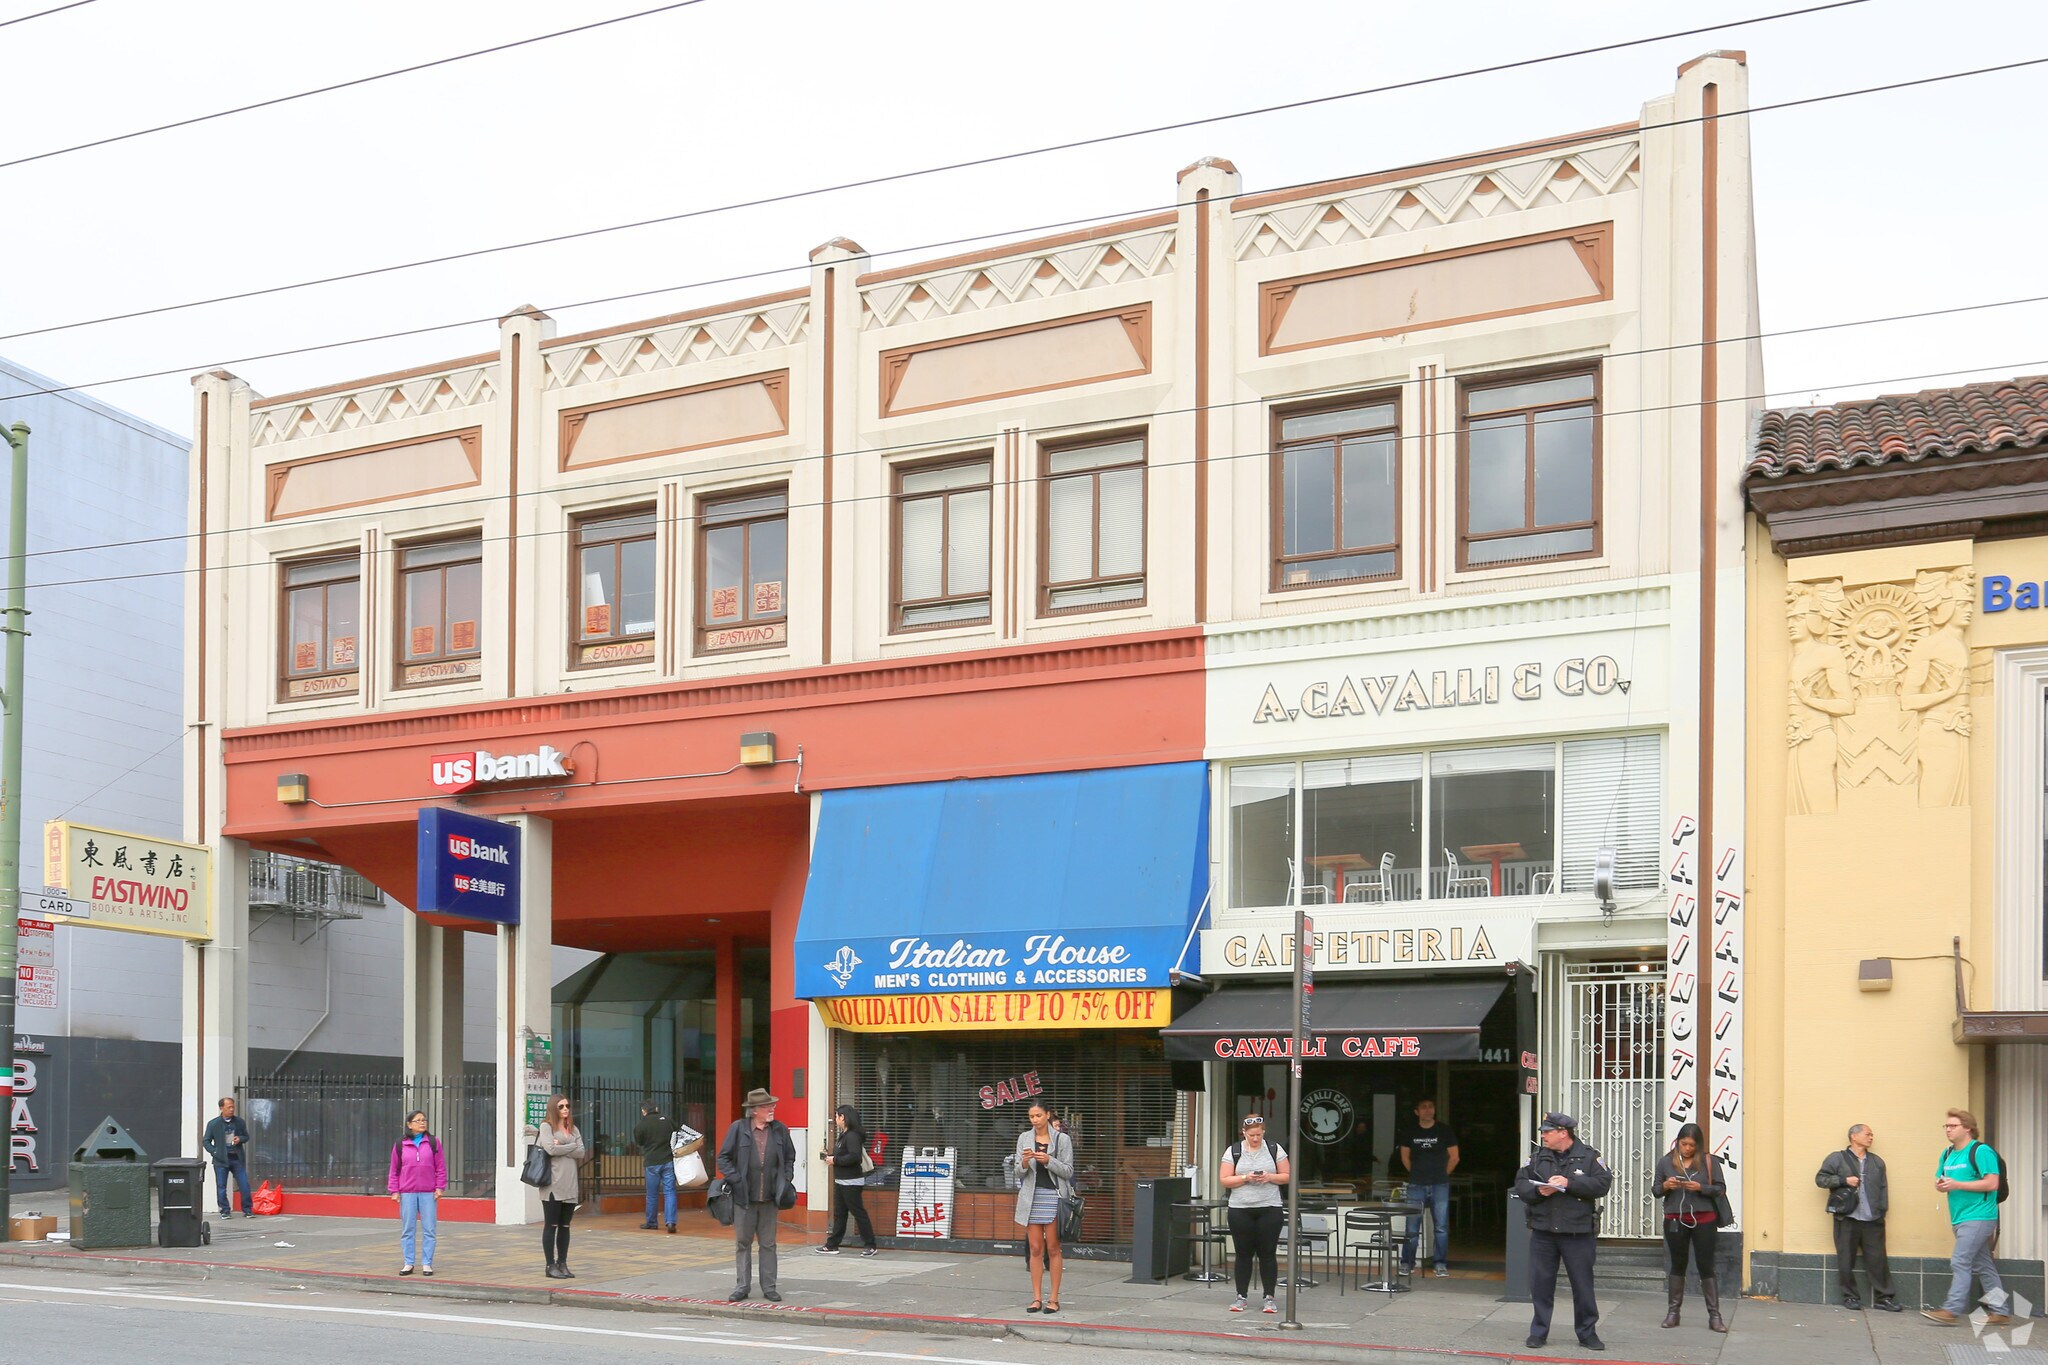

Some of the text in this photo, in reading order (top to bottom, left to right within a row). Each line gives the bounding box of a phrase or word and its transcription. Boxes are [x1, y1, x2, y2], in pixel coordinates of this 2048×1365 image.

[1983, 575, 2048, 614] Ba
[719, 626, 775, 646] EASTWIND
[593, 643, 645, 660] EASTWIND
[303, 677, 348, 692] EASTWIND
[1512, 662, 1542, 700] &
[91, 875, 189, 911] EASTWIND
[39, 899, 73, 913] CARD
[92, 902, 123, 915] BOOKS
[29, 930, 53, 938] STOPPING
[888, 935, 1131, 970] Italian House
[20, 967, 56, 978] NO DOUBLE
[874, 968, 1147, 989] MEN'S CLOTHING & ACCESSORIES
[20, 987, 55, 995] COMMERCIAL
[24, 992, 53, 1000] VEHICLES
[23, 998, 53, 1006] INCLUDED
[949, 994, 996, 1023] SALE
[1004, 993, 1031, 1022] UP
[1036, 992, 1064, 1021] TO
[1071, 991, 1110, 1021] 75%
[1115, 989, 1158, 1020] OFF
[1712, 846, 1742, 1171] ITALIANA
[1341, 1036, 1421, 1057] CAFE
[1479, 1048, 1510, 1062] 1441
[979, 1070, 1044, 1109] SALE
[1301, 1091, 1351, 1114] CAVALLI CAFE
[900, 1203, 945, 1228] SALE
